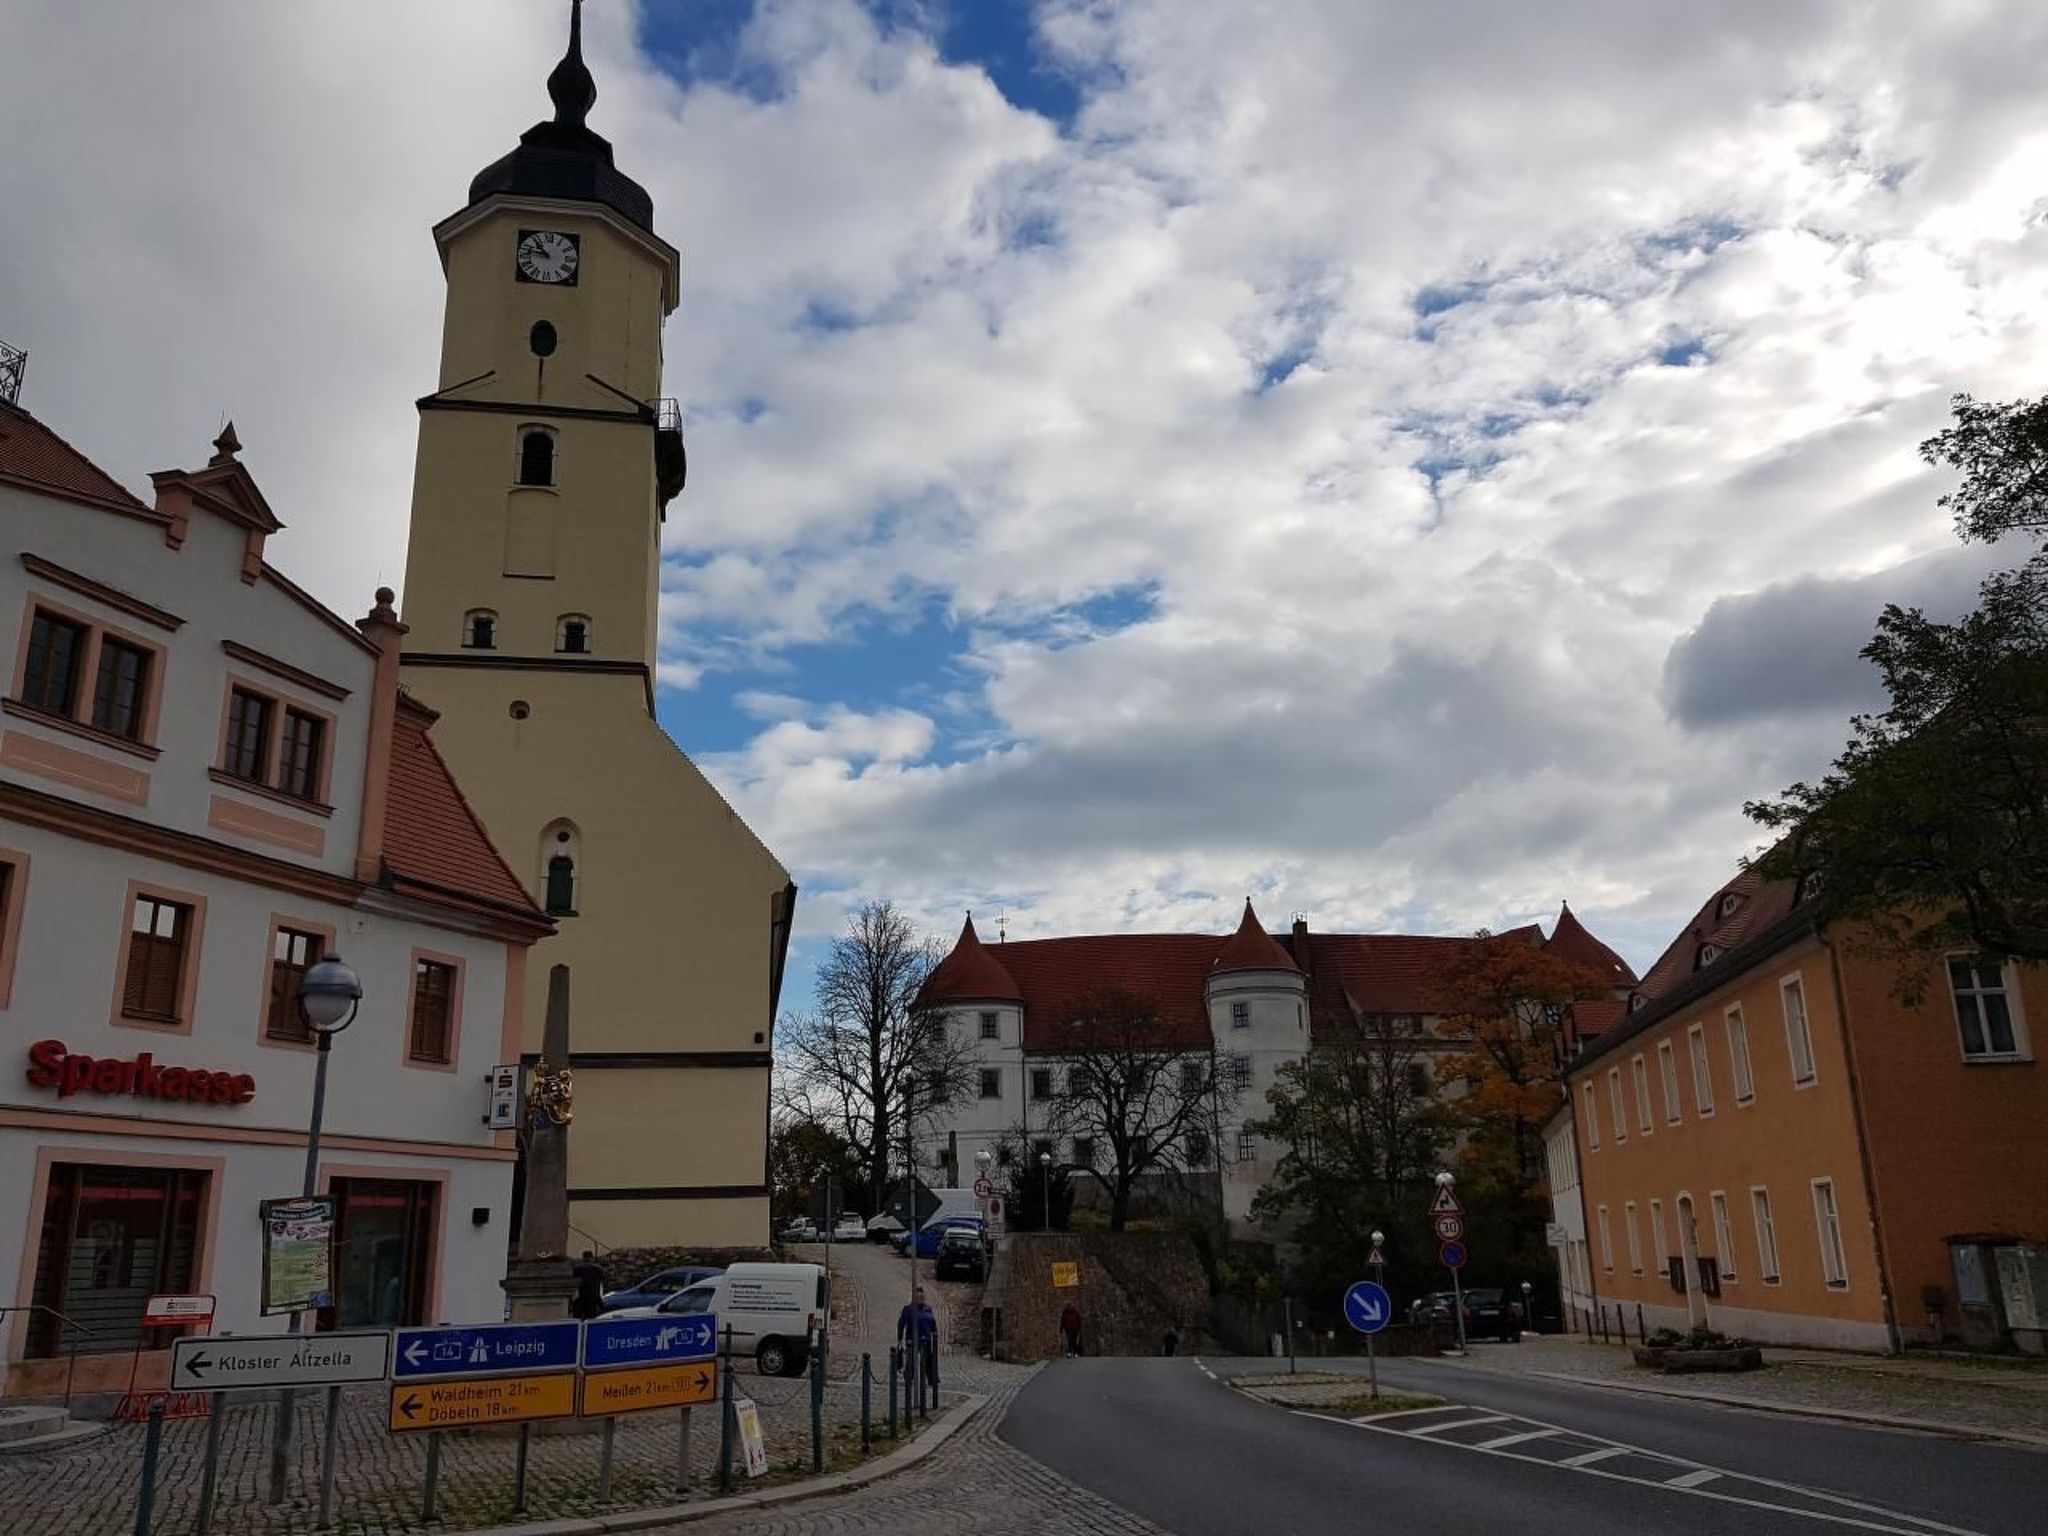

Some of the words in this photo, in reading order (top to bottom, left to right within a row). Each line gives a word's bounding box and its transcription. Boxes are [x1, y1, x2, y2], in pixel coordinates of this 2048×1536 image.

[26, 1039, 256, 1103] Sparkasse
[1442, 1222, 1457, 1232] 30
[496, 1341, 545, 1356] Leipzig
[607, 1337, 651, 1349] Dresden
[218, 1356, 281, 1370] Kloster
[289, 1353, 351, 1368] Altzella
[431, 1385, 501, 1401] Waldheim
[603, 1384, 641, 1398] Meißen
[429, 1406, 479, 1421] Döbeln
